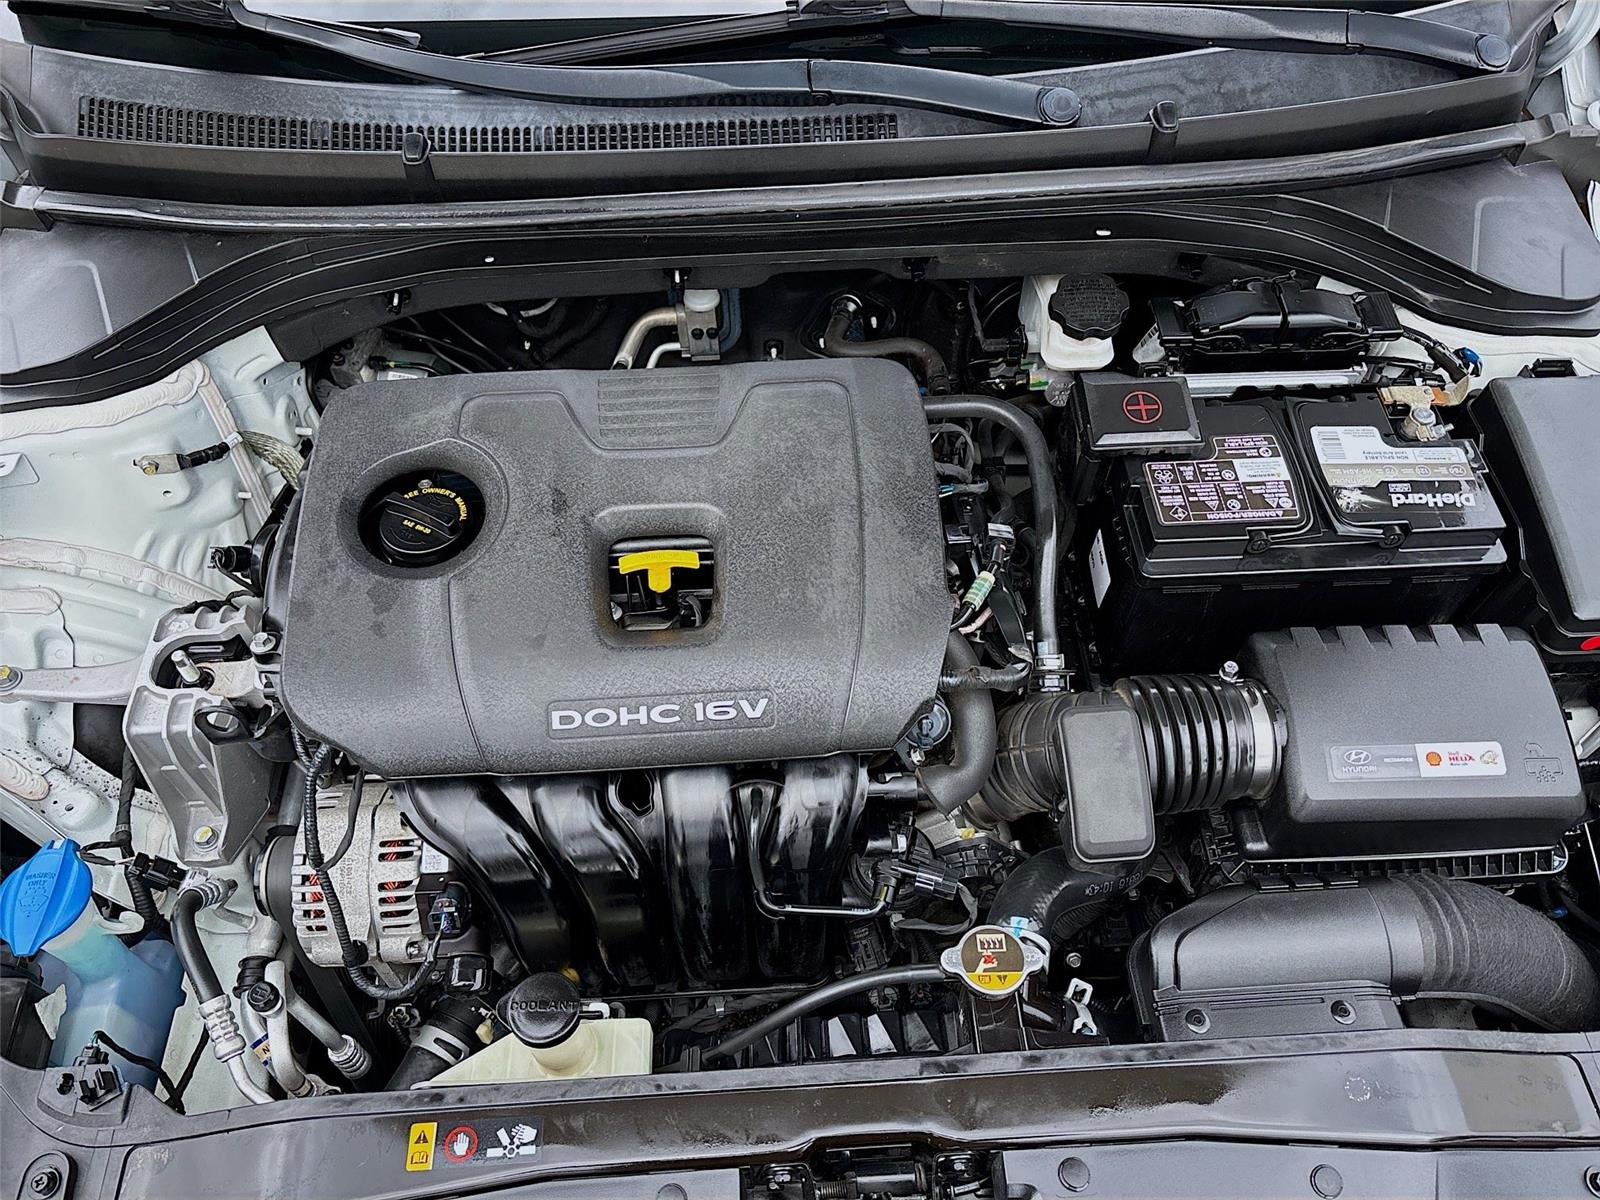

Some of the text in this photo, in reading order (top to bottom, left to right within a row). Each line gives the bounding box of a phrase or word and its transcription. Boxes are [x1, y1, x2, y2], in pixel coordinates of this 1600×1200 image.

[422, 488, 456, 498] OWNER'S
[1389, 493, 1476, 508] DieHard
[551, 698, 769, 730] DOHC 16V
[1343, 765, 1377, 773] HYUNDAI
[511, 1000, 578, 1012] COOLANT
